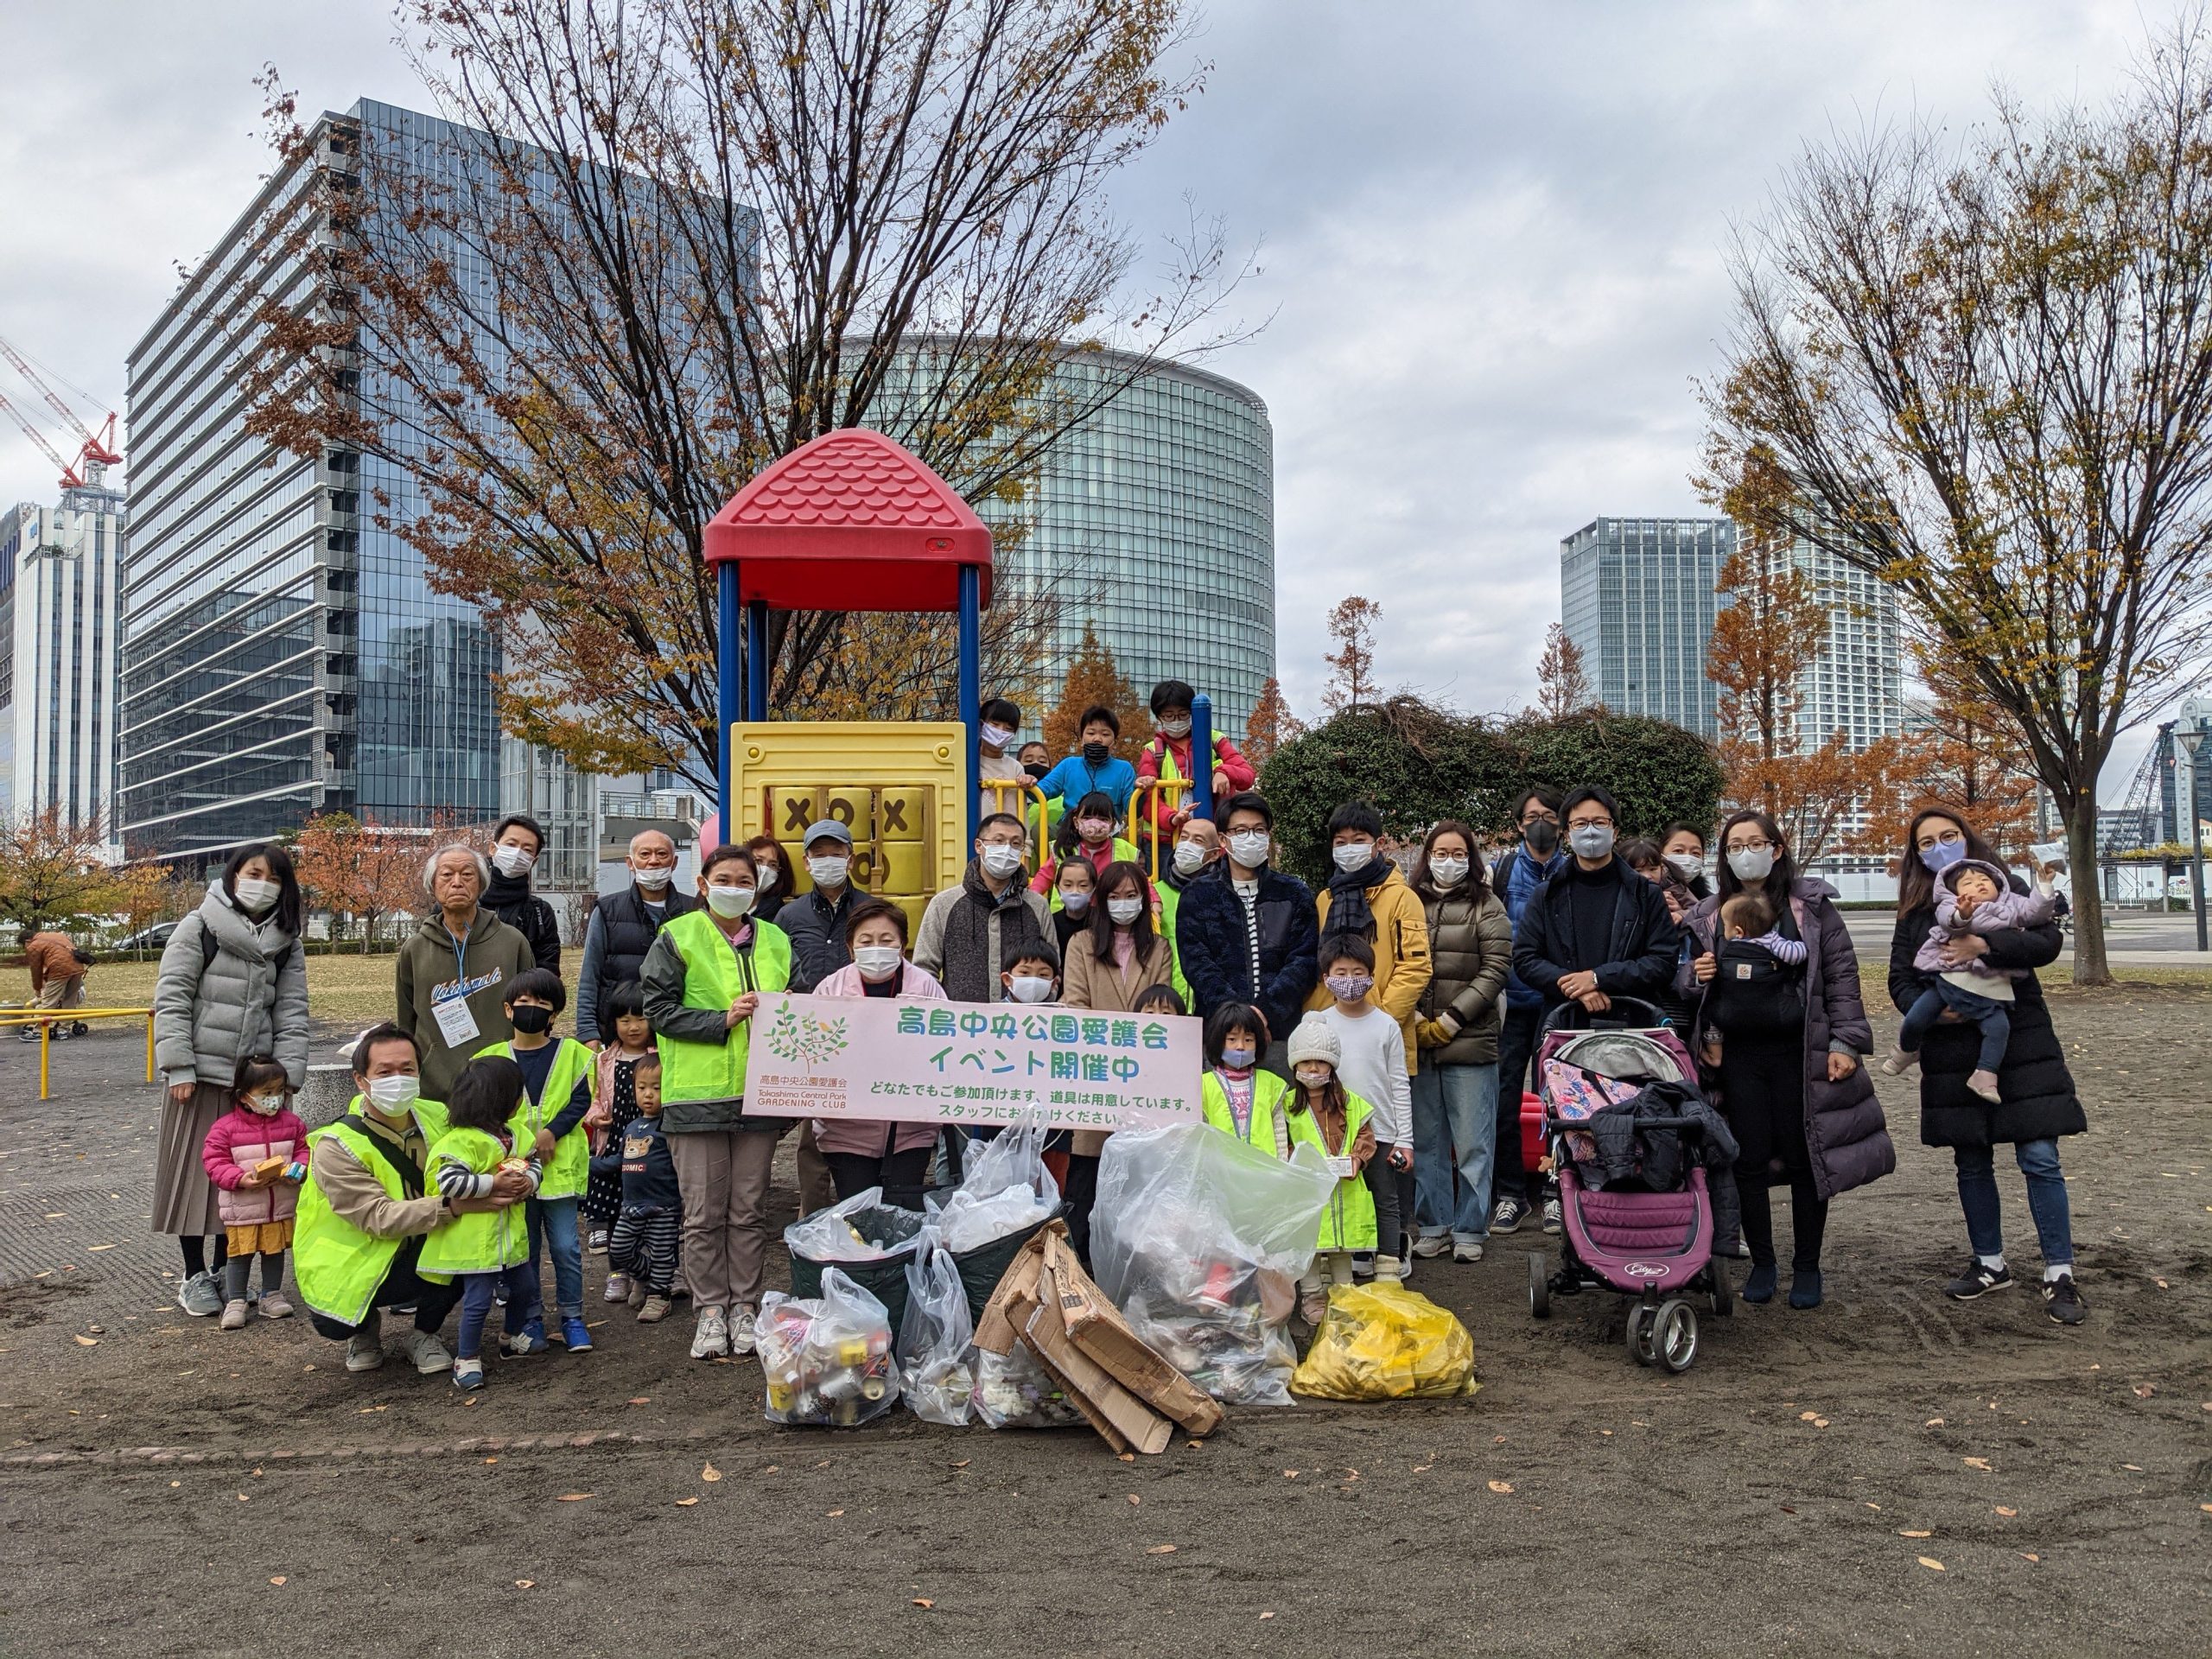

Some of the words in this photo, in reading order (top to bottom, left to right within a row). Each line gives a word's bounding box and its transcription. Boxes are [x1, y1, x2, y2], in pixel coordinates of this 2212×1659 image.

[897, 1006, 1168, 1050] 高島中央公園愛護会
[930, 1046, 1140, 1084] イベント開催中
[760, 1075, 847, 1088] 高島中央公園愛護会
[757, 1098, 816, 1108] GARDENING
[822, 1100, 846, 1109] CLUB
[758, 1090, 799, 1098] Takashima
[800, 1090, 828, 1100] Central
[938, 1104, 1123, 1125] スタッフにおけください。
